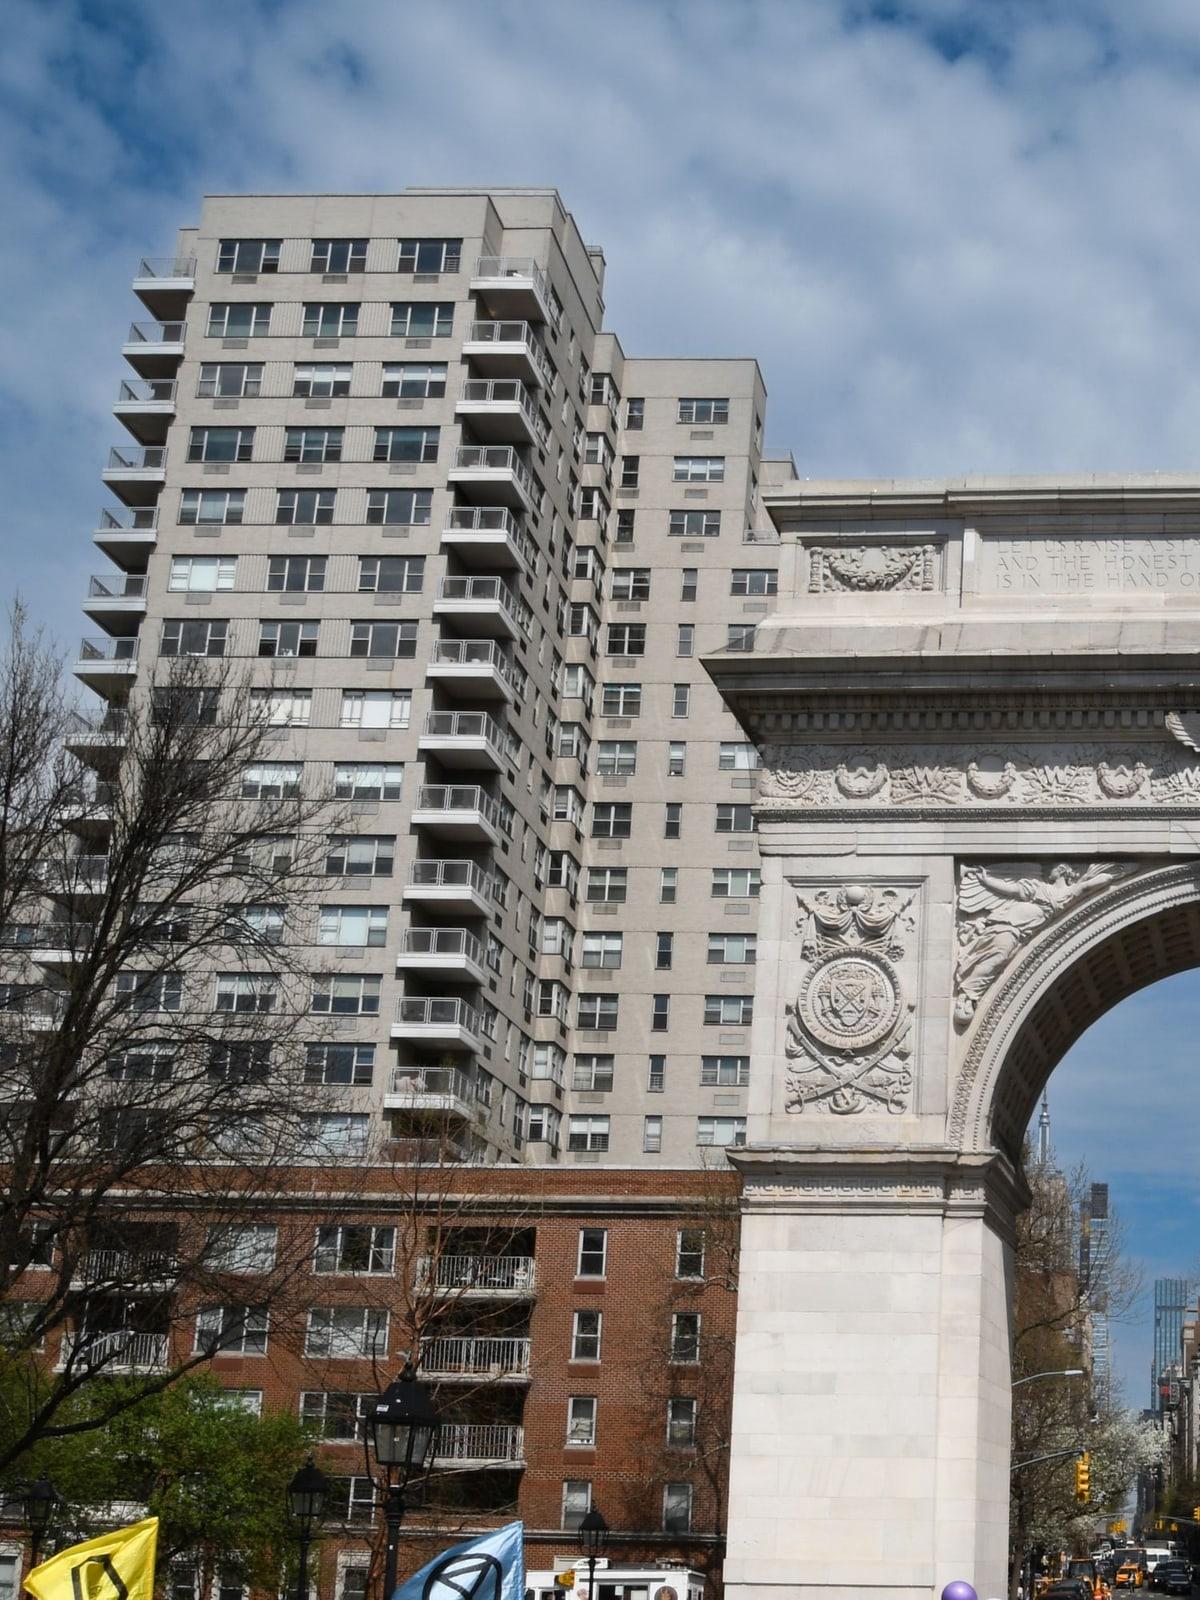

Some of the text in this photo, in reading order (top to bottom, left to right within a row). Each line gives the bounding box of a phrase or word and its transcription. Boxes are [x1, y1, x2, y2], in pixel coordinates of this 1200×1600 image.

[1045, 538, 1067, 552] US
[1073, 537, 1133, 552] RAISE
[1144, 537, 1157, 551] A
[998, 556, 1039, 571] AND
[1048, 555, 1091, 570] THE
[1104, 554, 1192, 570] HONEST
[996, 574, 1012, 588] IS
[1022, 573, 1041, 588] IN
[1050, 573, 1094, 588] THE
[1106, 572, 1169, 587] HAND
